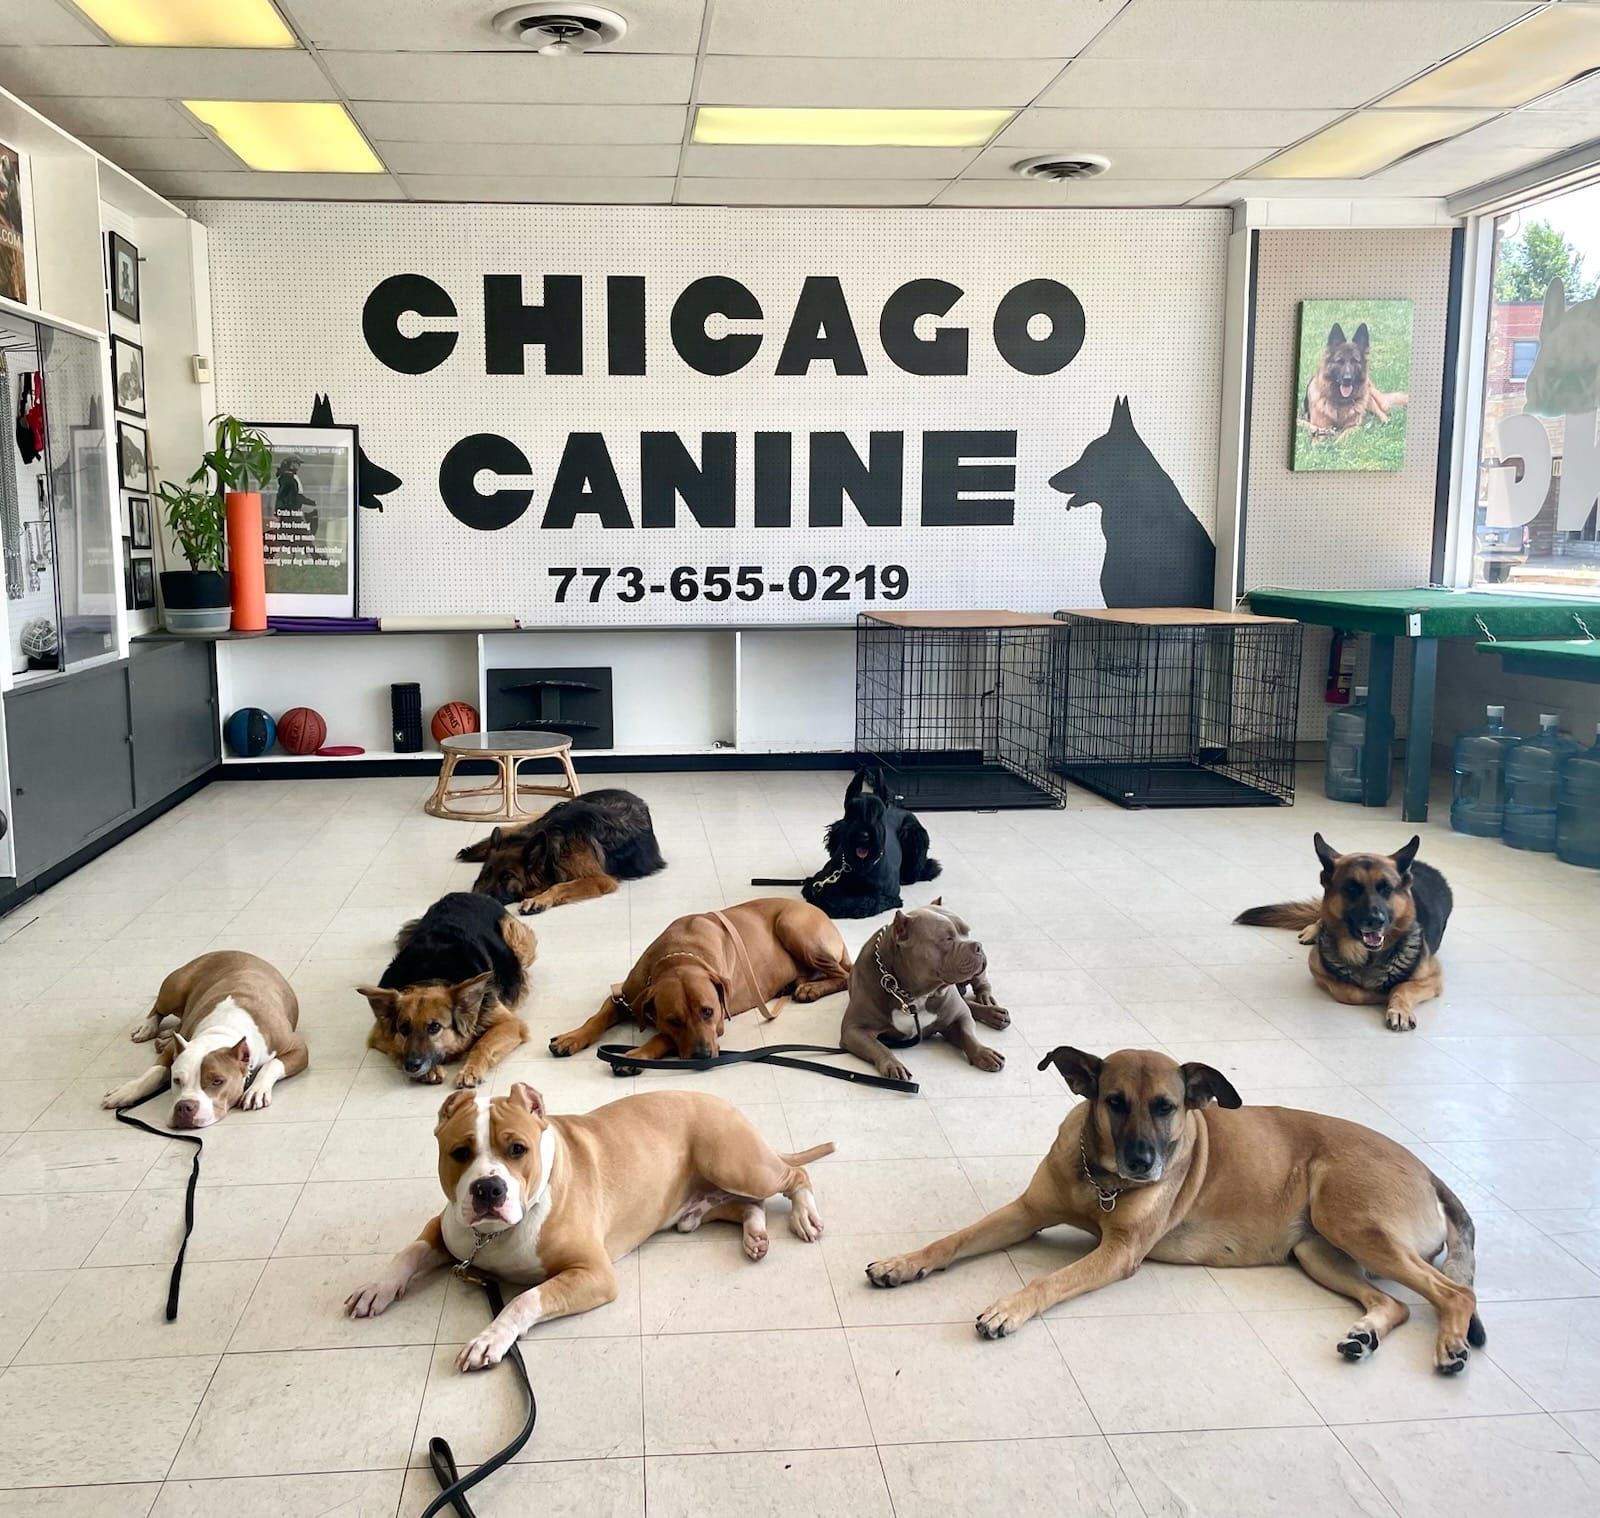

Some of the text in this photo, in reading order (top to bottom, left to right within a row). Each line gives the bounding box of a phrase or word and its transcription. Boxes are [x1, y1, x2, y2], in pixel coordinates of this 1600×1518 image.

[362, 274, 1086, 376] CHICAGO
[439, 430, 1017, 531] CANINE
[269, 521, 280, 529] Stop
[264, 533, 276, 541] Stop
[277, 533, 294, 543] talking
[301, 533, 315, 541] much
[269, 546, 280, 554] your
[281, 545, 291, 555] dog
[291, 545, 305, 555] using
[281, 559, 293, 567] your
[293, 558, 303, 567] dog
[303, 558, 314, 566] with
[314, 558, 328, 566] other
[329, 559, 341, 567] dogs
[548, 565, 909, 603] 773-655-0219
